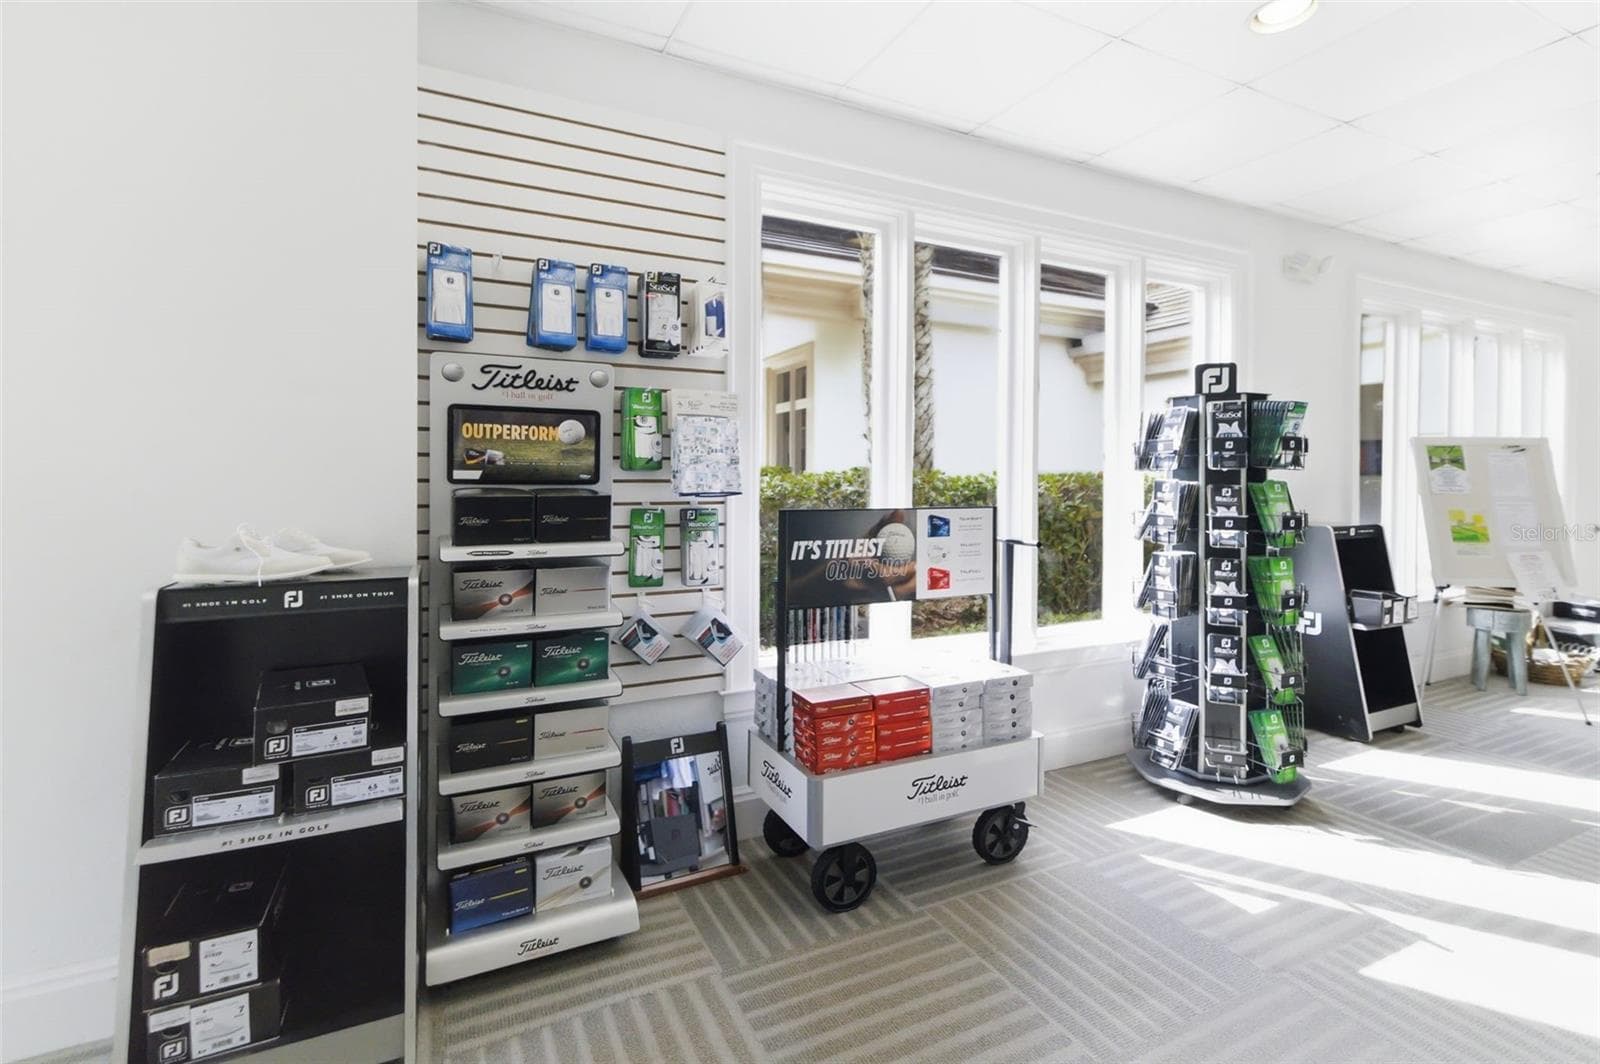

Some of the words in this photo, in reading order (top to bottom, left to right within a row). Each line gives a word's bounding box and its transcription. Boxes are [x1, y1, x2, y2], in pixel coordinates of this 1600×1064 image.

[429, 243, 441, 255] FJ
[472, 364, 580, 392] Titleist
[1202, 367, 1230, 394] FJ
[462, 422, 561, 442] OUTPERFORM
[791, 540, 822, 561] IT'S
[825, 538, 885, 559] TITLEIST
[825, 560, 849, 582] OR
[459, 579, 504, 591] Titleist
[283, 590, 304, 609] FJ
[458, 651, 503, 666] Titleist
[542, 645, 583, 659] Titleist
[268, 739, 285, 754] FJ
[670, 737, 685, 755] FJ
[760, 759, 793, 799] Titleist
[907, 774, 969, 801] Titleist
[309, 788, 326, 803] FJ
[538, 785, 579, 800] Titleist
[168, 807, 188, 824] FJ
[457, 800, 501, 815] Titleist
[240, 833, 272, 844] SHOE
[280, 829, 293, 837] IN
[299, 823, 330, 834] GOLF
[542, 864, 584, 881] Titleist
[246, 941, 253, 949] 7
[517, 936, 560, 956] Titleist
[153, 972, 180, 1001] FJ
[238, 1005, 245, 1013] 7
[163, 1041, 183, 1060] FJ
